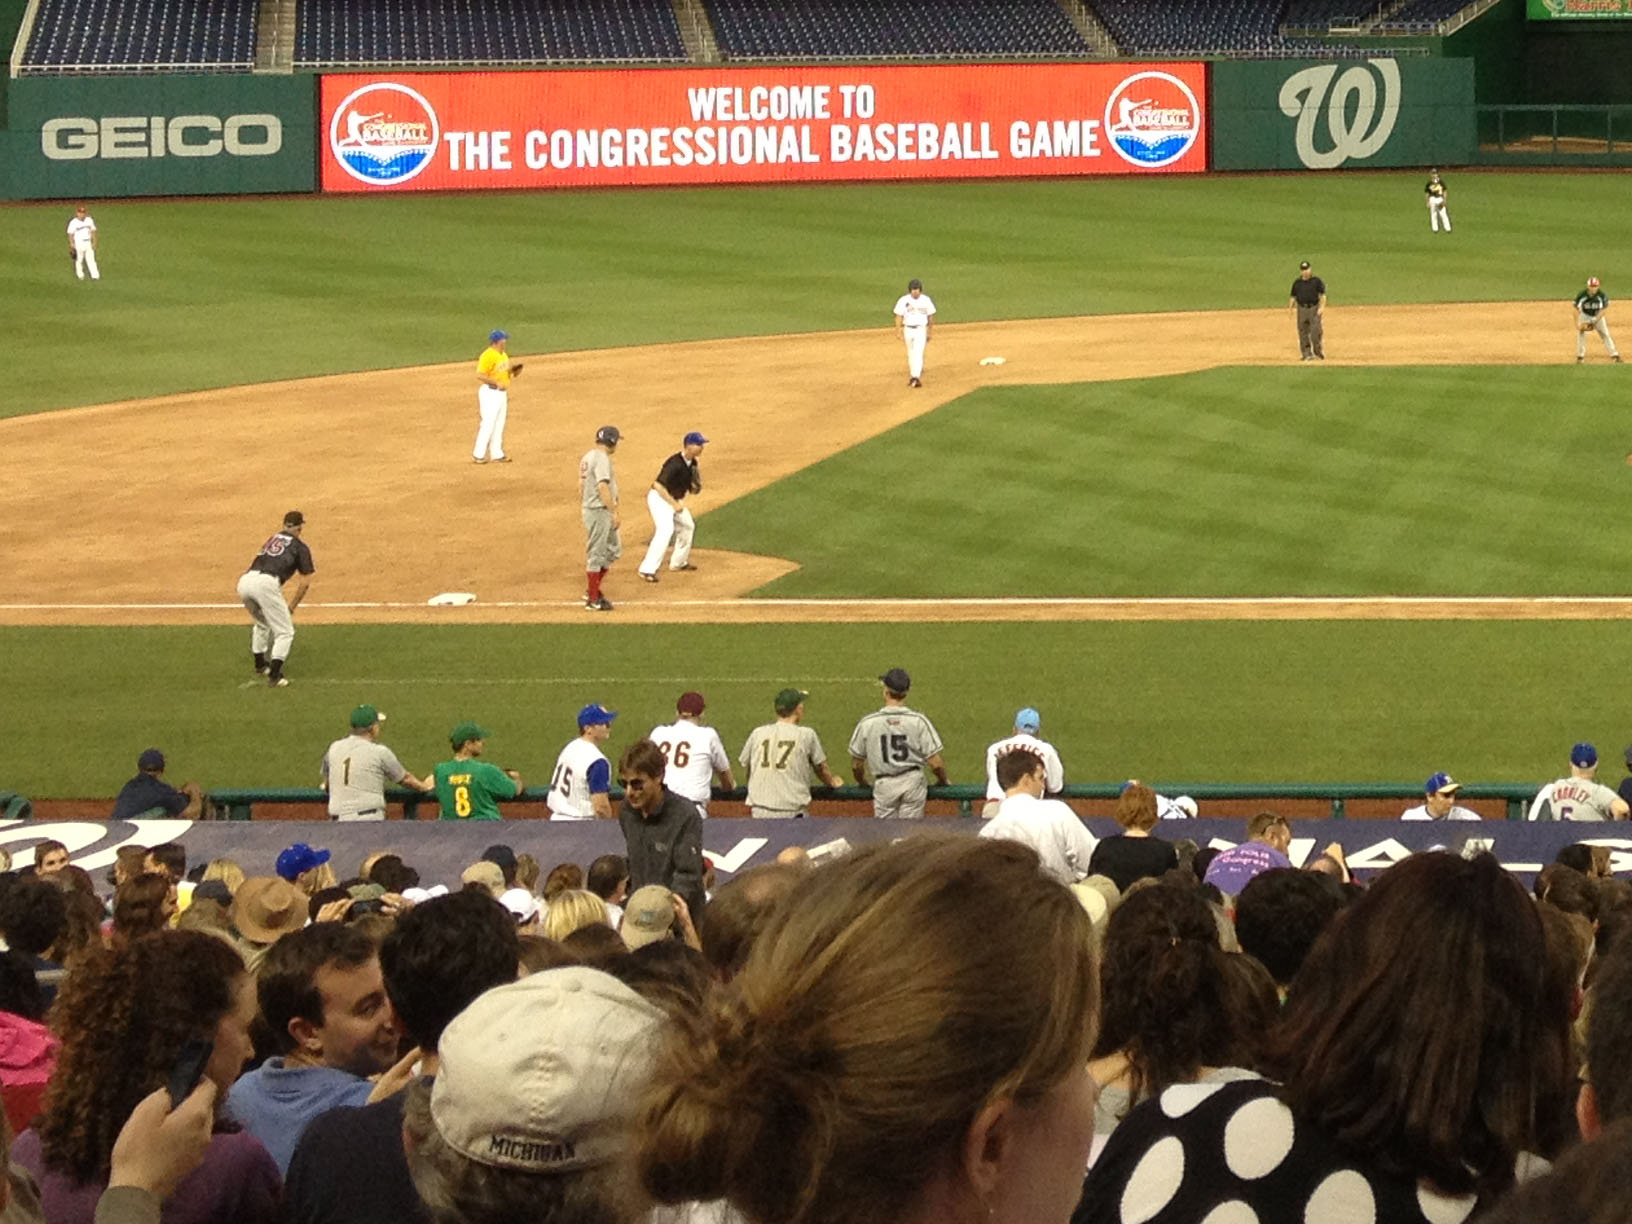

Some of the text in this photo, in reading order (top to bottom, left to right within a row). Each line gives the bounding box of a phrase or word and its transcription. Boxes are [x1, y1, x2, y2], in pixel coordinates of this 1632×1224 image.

[688, 85, 875, 123] WELCOME TO
[1278, 58, 1402, 170] W
[42, 115, 282, 160] GEICO
[444, 118, 1101, 171] THE CONGRESSIONAL BASEBALL GAME
[760, 738, 796, 770] 17
[880, 734, 910, 764] 15
[343, 757, 351, 786] 1
[551, 764, 573, 799] 15
[488, 1135, 576, 1161] MICHIGAN
